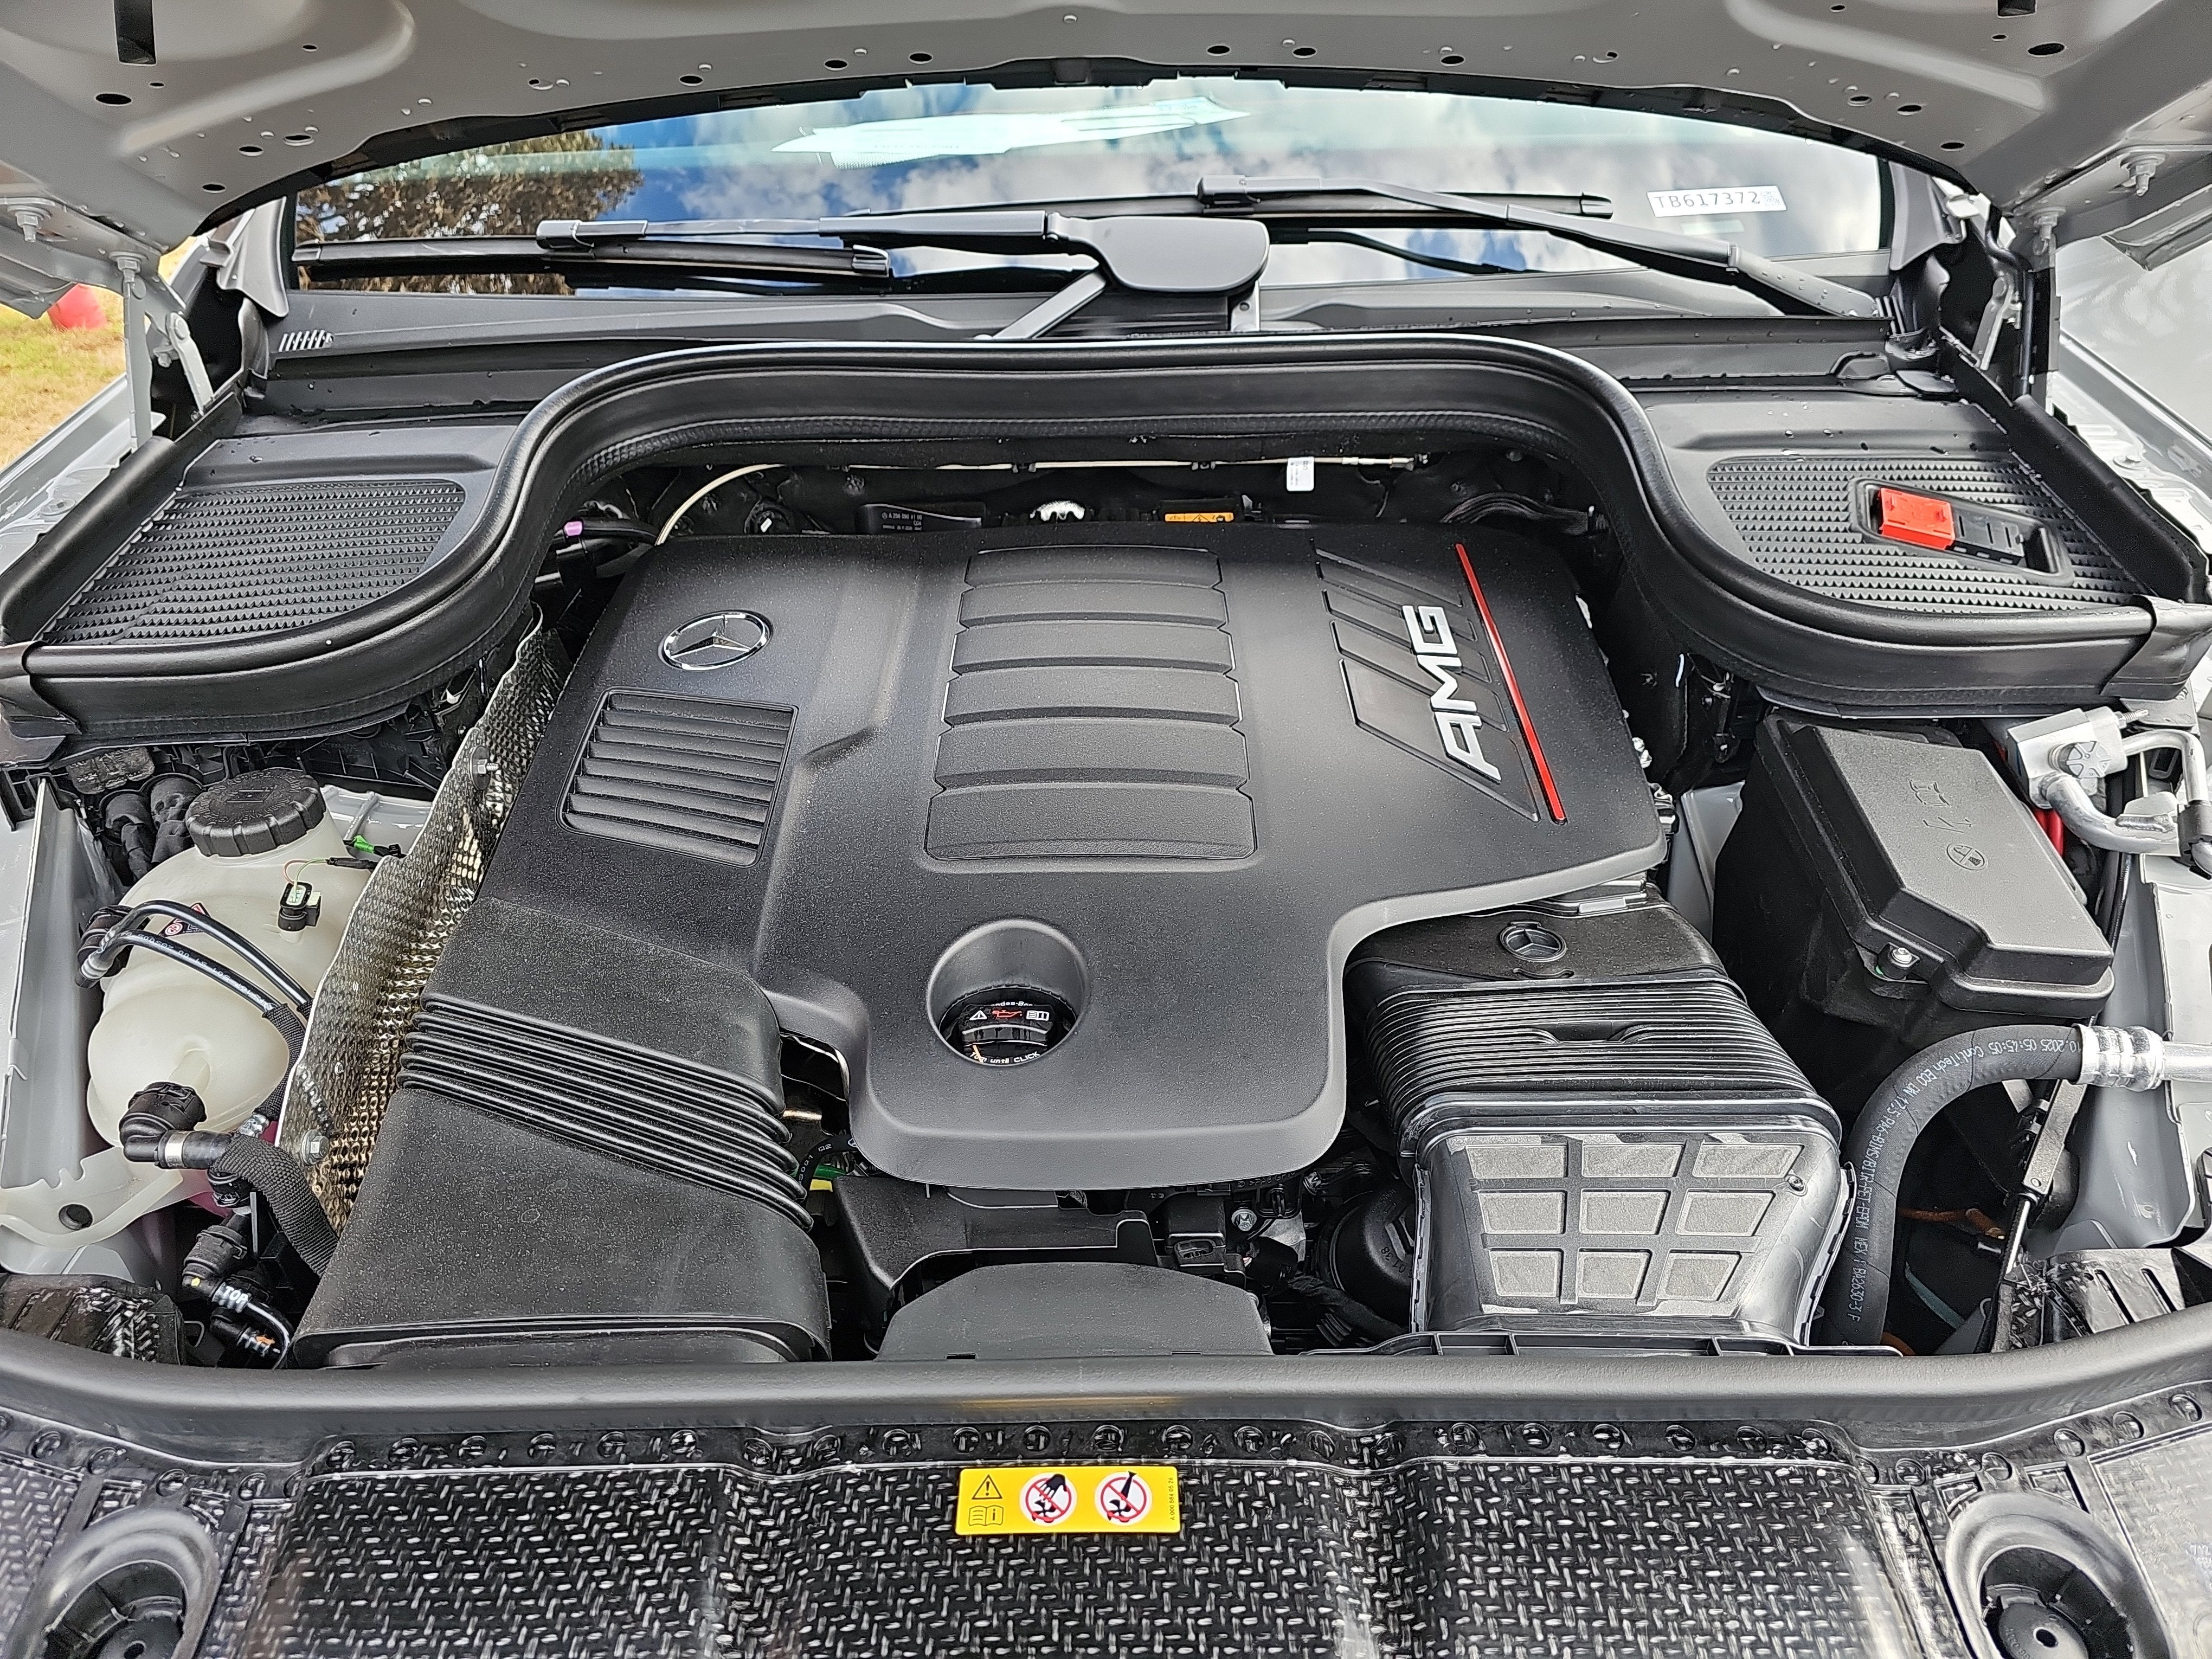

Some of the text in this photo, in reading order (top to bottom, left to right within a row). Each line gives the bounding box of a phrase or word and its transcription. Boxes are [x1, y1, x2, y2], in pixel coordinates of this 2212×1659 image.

[1654, 191, 1761, 209] TB617372
[1401, 605, 1501, 783] AMG
[1988, 1039, 2037, 1054] 05:45:05
[1013, 1051, 1040, 1063] CLICK
[1932, 1045, 1984, 1073] ContiTech
[1915, 1068, 1935, 1087] ECO
[223, 1285, 249, 1304] TOP
